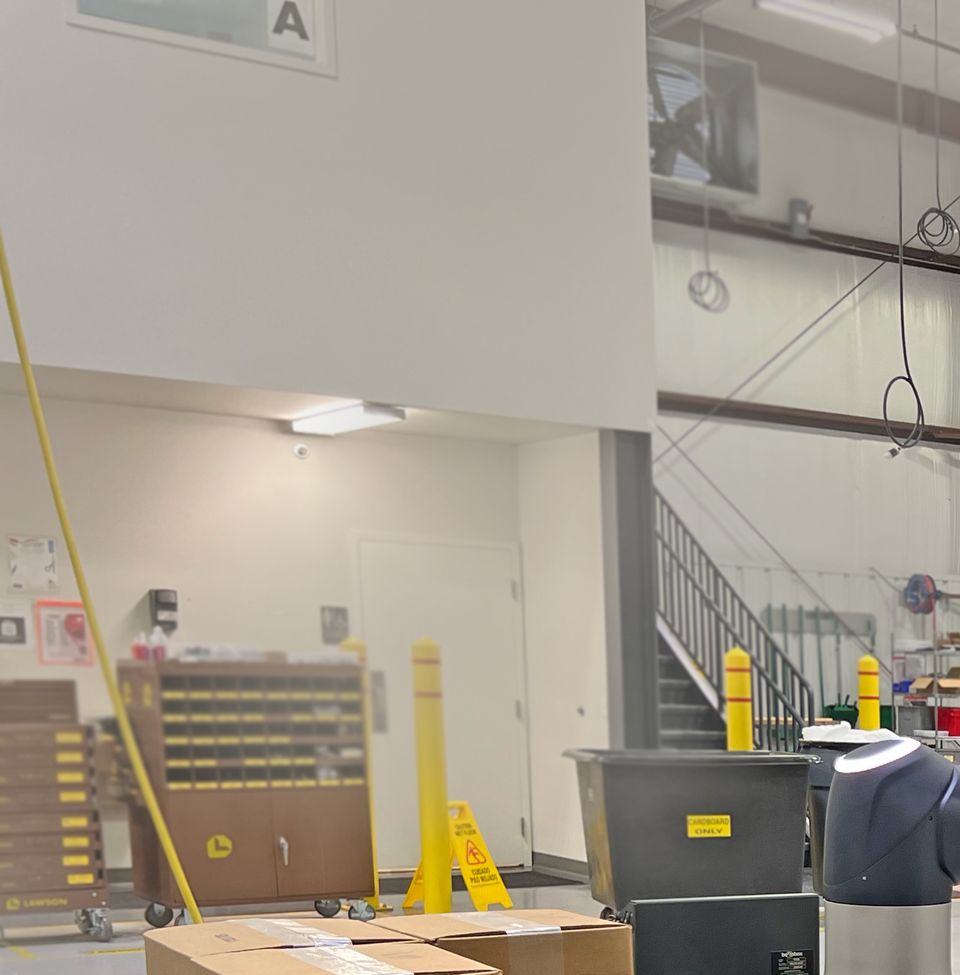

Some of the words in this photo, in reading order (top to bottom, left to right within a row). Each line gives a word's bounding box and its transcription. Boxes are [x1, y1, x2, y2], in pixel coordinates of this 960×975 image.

[272, 0, 311, 42] A
[688, 817, 729, 825] CARDBOARD
[694, 827, 722, 835] ONLY
[23, 898, 68, 908] LAWSON
